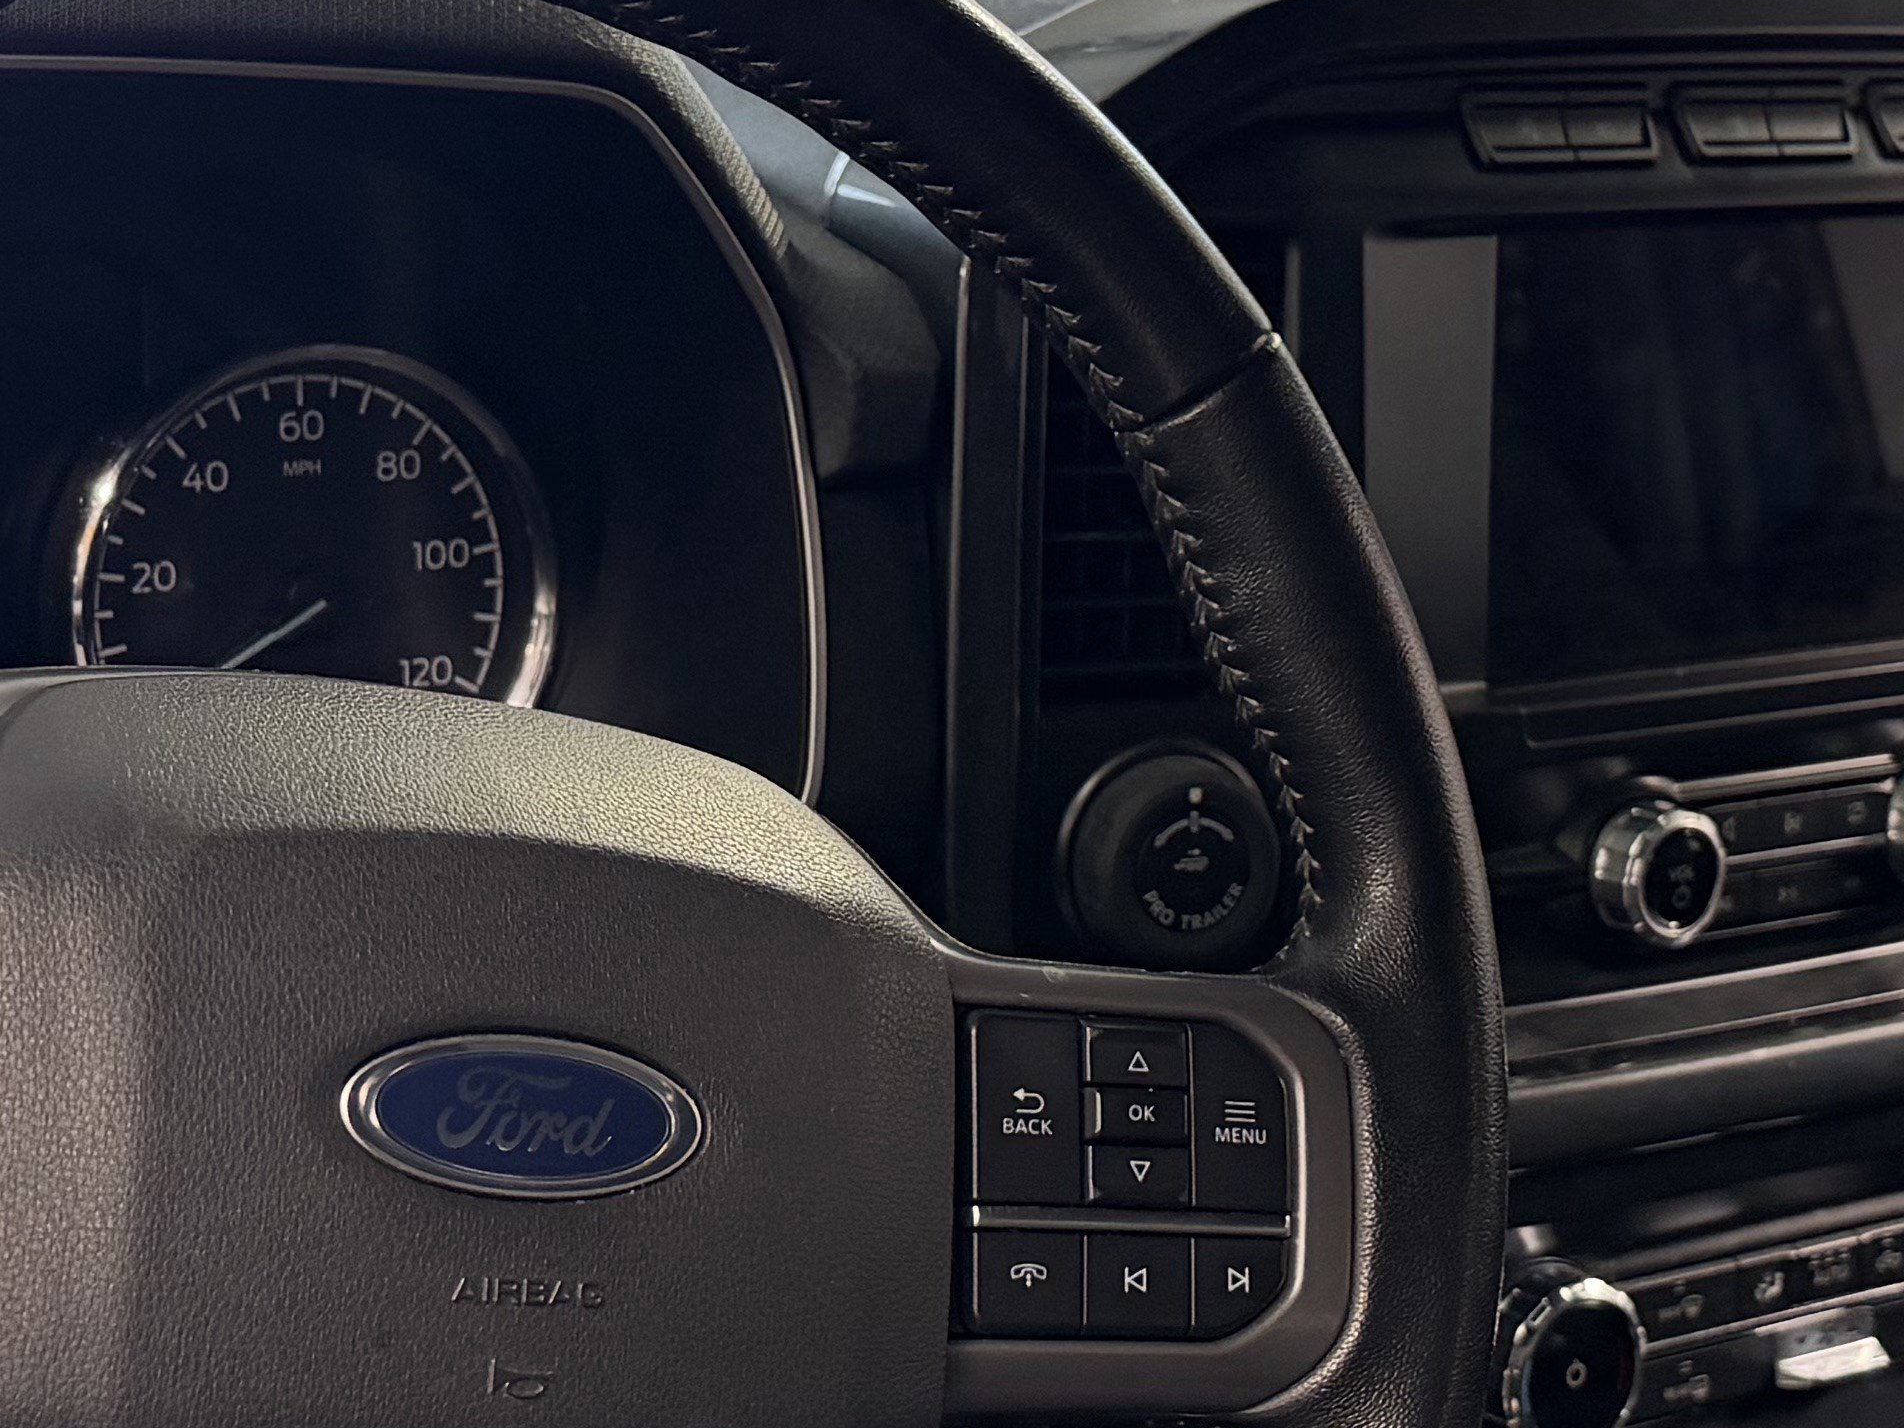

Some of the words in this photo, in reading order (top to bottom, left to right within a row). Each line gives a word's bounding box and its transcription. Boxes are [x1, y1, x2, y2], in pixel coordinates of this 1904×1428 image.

[278, 409, 325, 443] 60
[181, 460, 230, 494] 40
[282, 458, 323, 477] MPH
[375, 449, 422, 483] 80
[412, 537, 471, 572] 100
[130, 560, 178, 595] 20
[399, 654, 453, 687] 120
[1142, 889, 1176, 927] PRO
[436, 1065, 616, 1157] Ford
[1002, 1117, 1054, 1135] BACK
[1128, 1104, 1156, 1123] OK
[1213, 1126, 1268, 1145] MENU
[450, 1276, 604, 1308] AIRBAG
